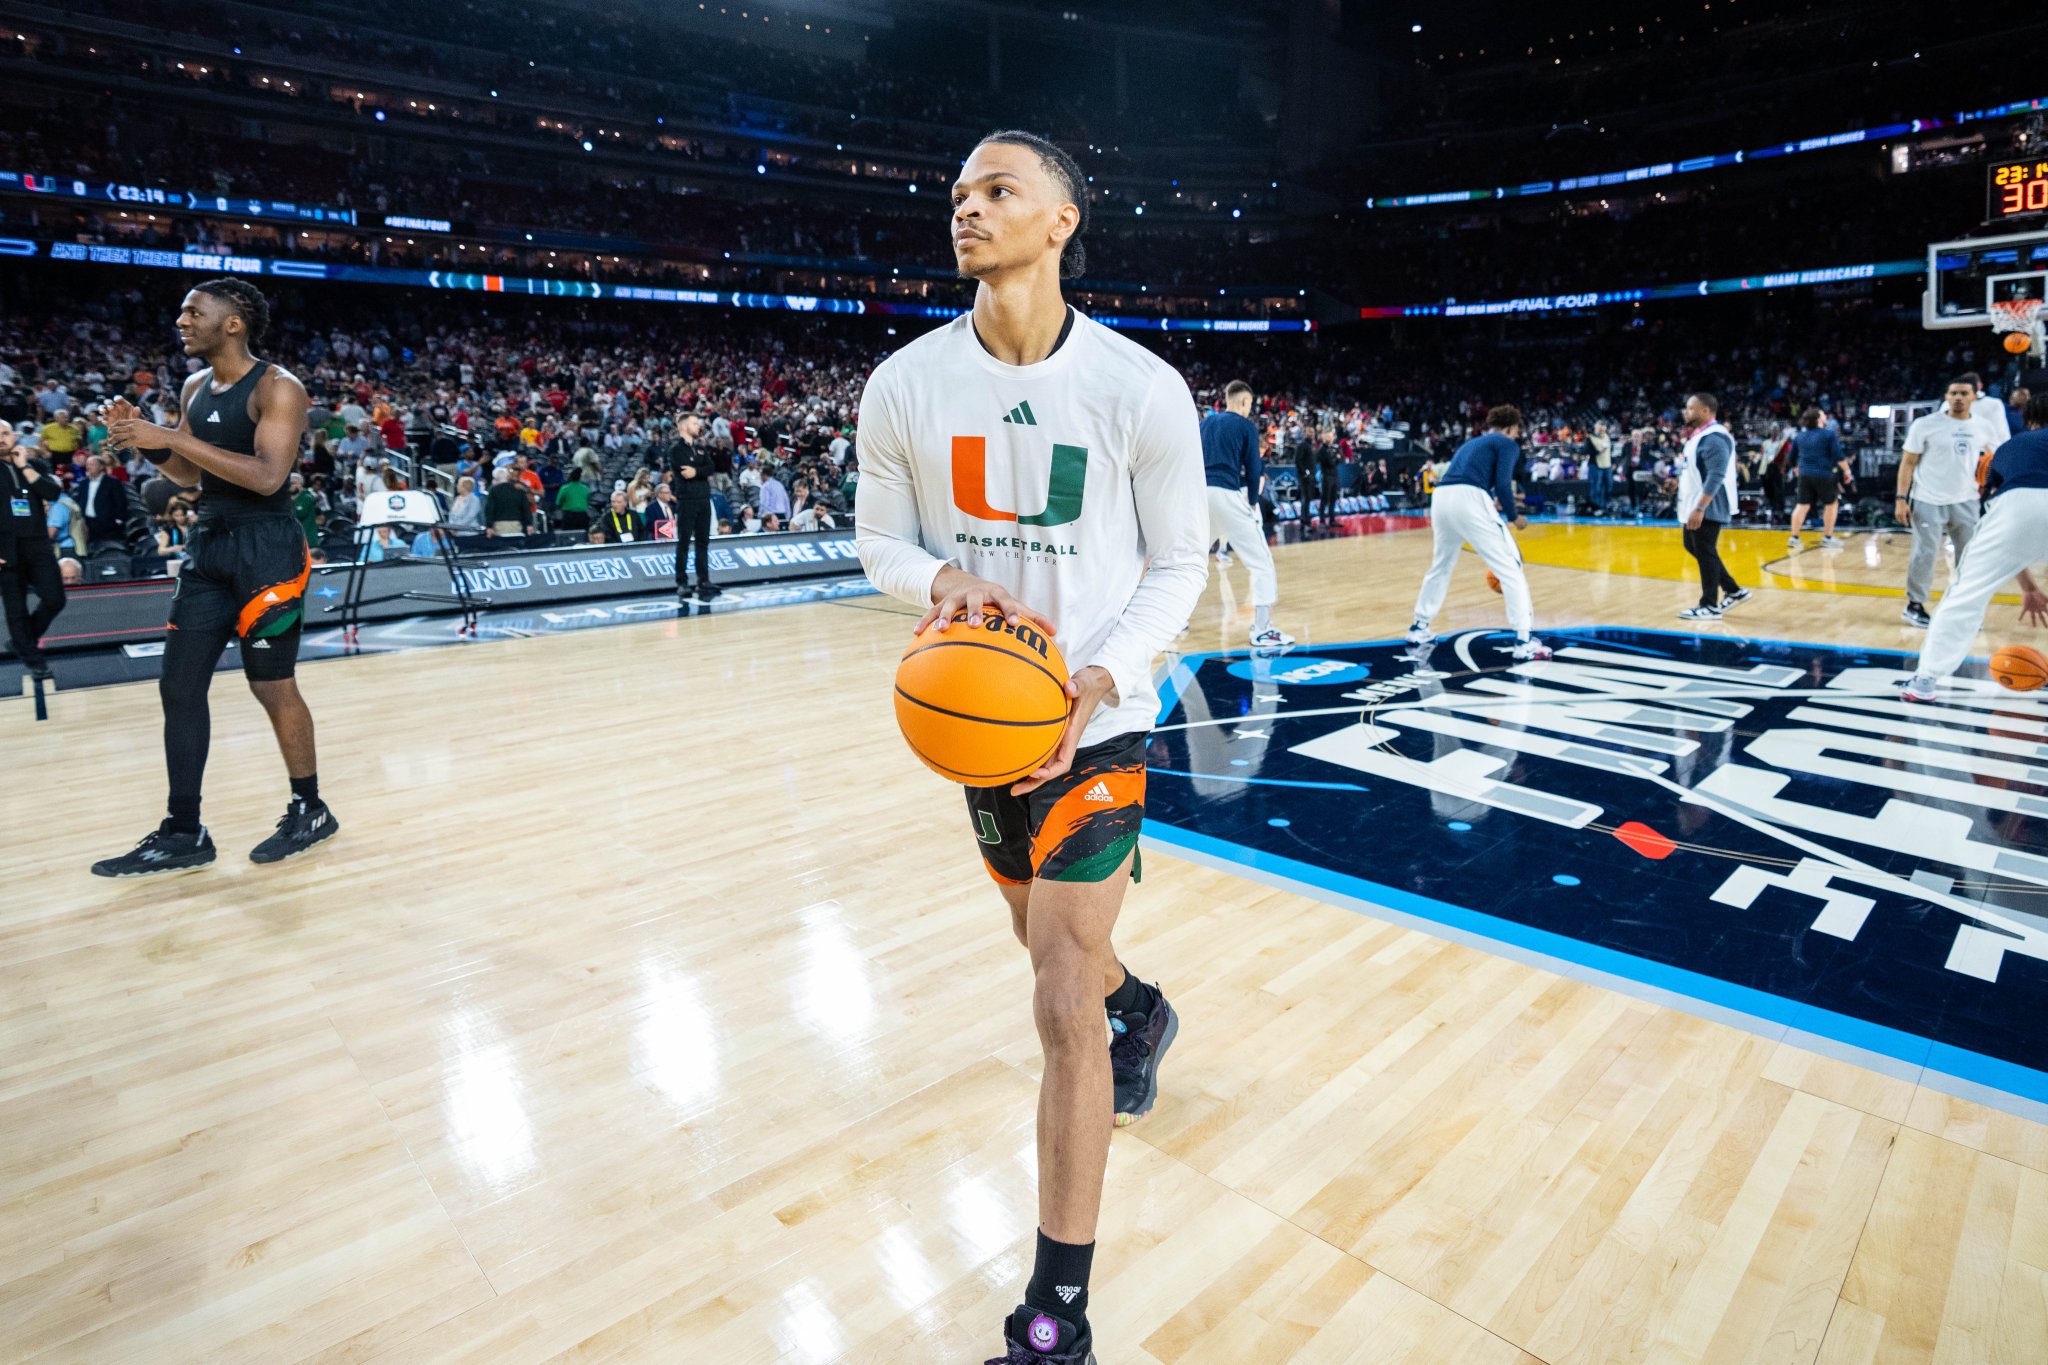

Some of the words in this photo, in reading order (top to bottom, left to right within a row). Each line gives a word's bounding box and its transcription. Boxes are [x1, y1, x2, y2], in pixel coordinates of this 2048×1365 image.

[118, 185, 165, 204] 23:14
[2003, 180, 2048, 213] 30
[182, 253, 222, 270] WERE
[223, 256, 262, 273] FOUR
[1763, 273, 1799, 288] MIAMI
[1800, 264, 1875, 284] HURRICANES
[1509, 298, 1553, 312] FINAL
[1555, 293, 1598, 309] FOUR
[951, 436, 1088, 527] U
[955, 532, 1078, 556] BASKETBALL
[534, 557, 632, 586] THEN
[735, 539, 823, 567] WERE
[818, 539, 858, 560] FO
[1005, 551, 1057, 565] CHPTER
[541, 579, 877, 624] HOUSTO
[1288, 647, 1806, 829] FINAL
[1084, 793, 1114, 803] adidas
